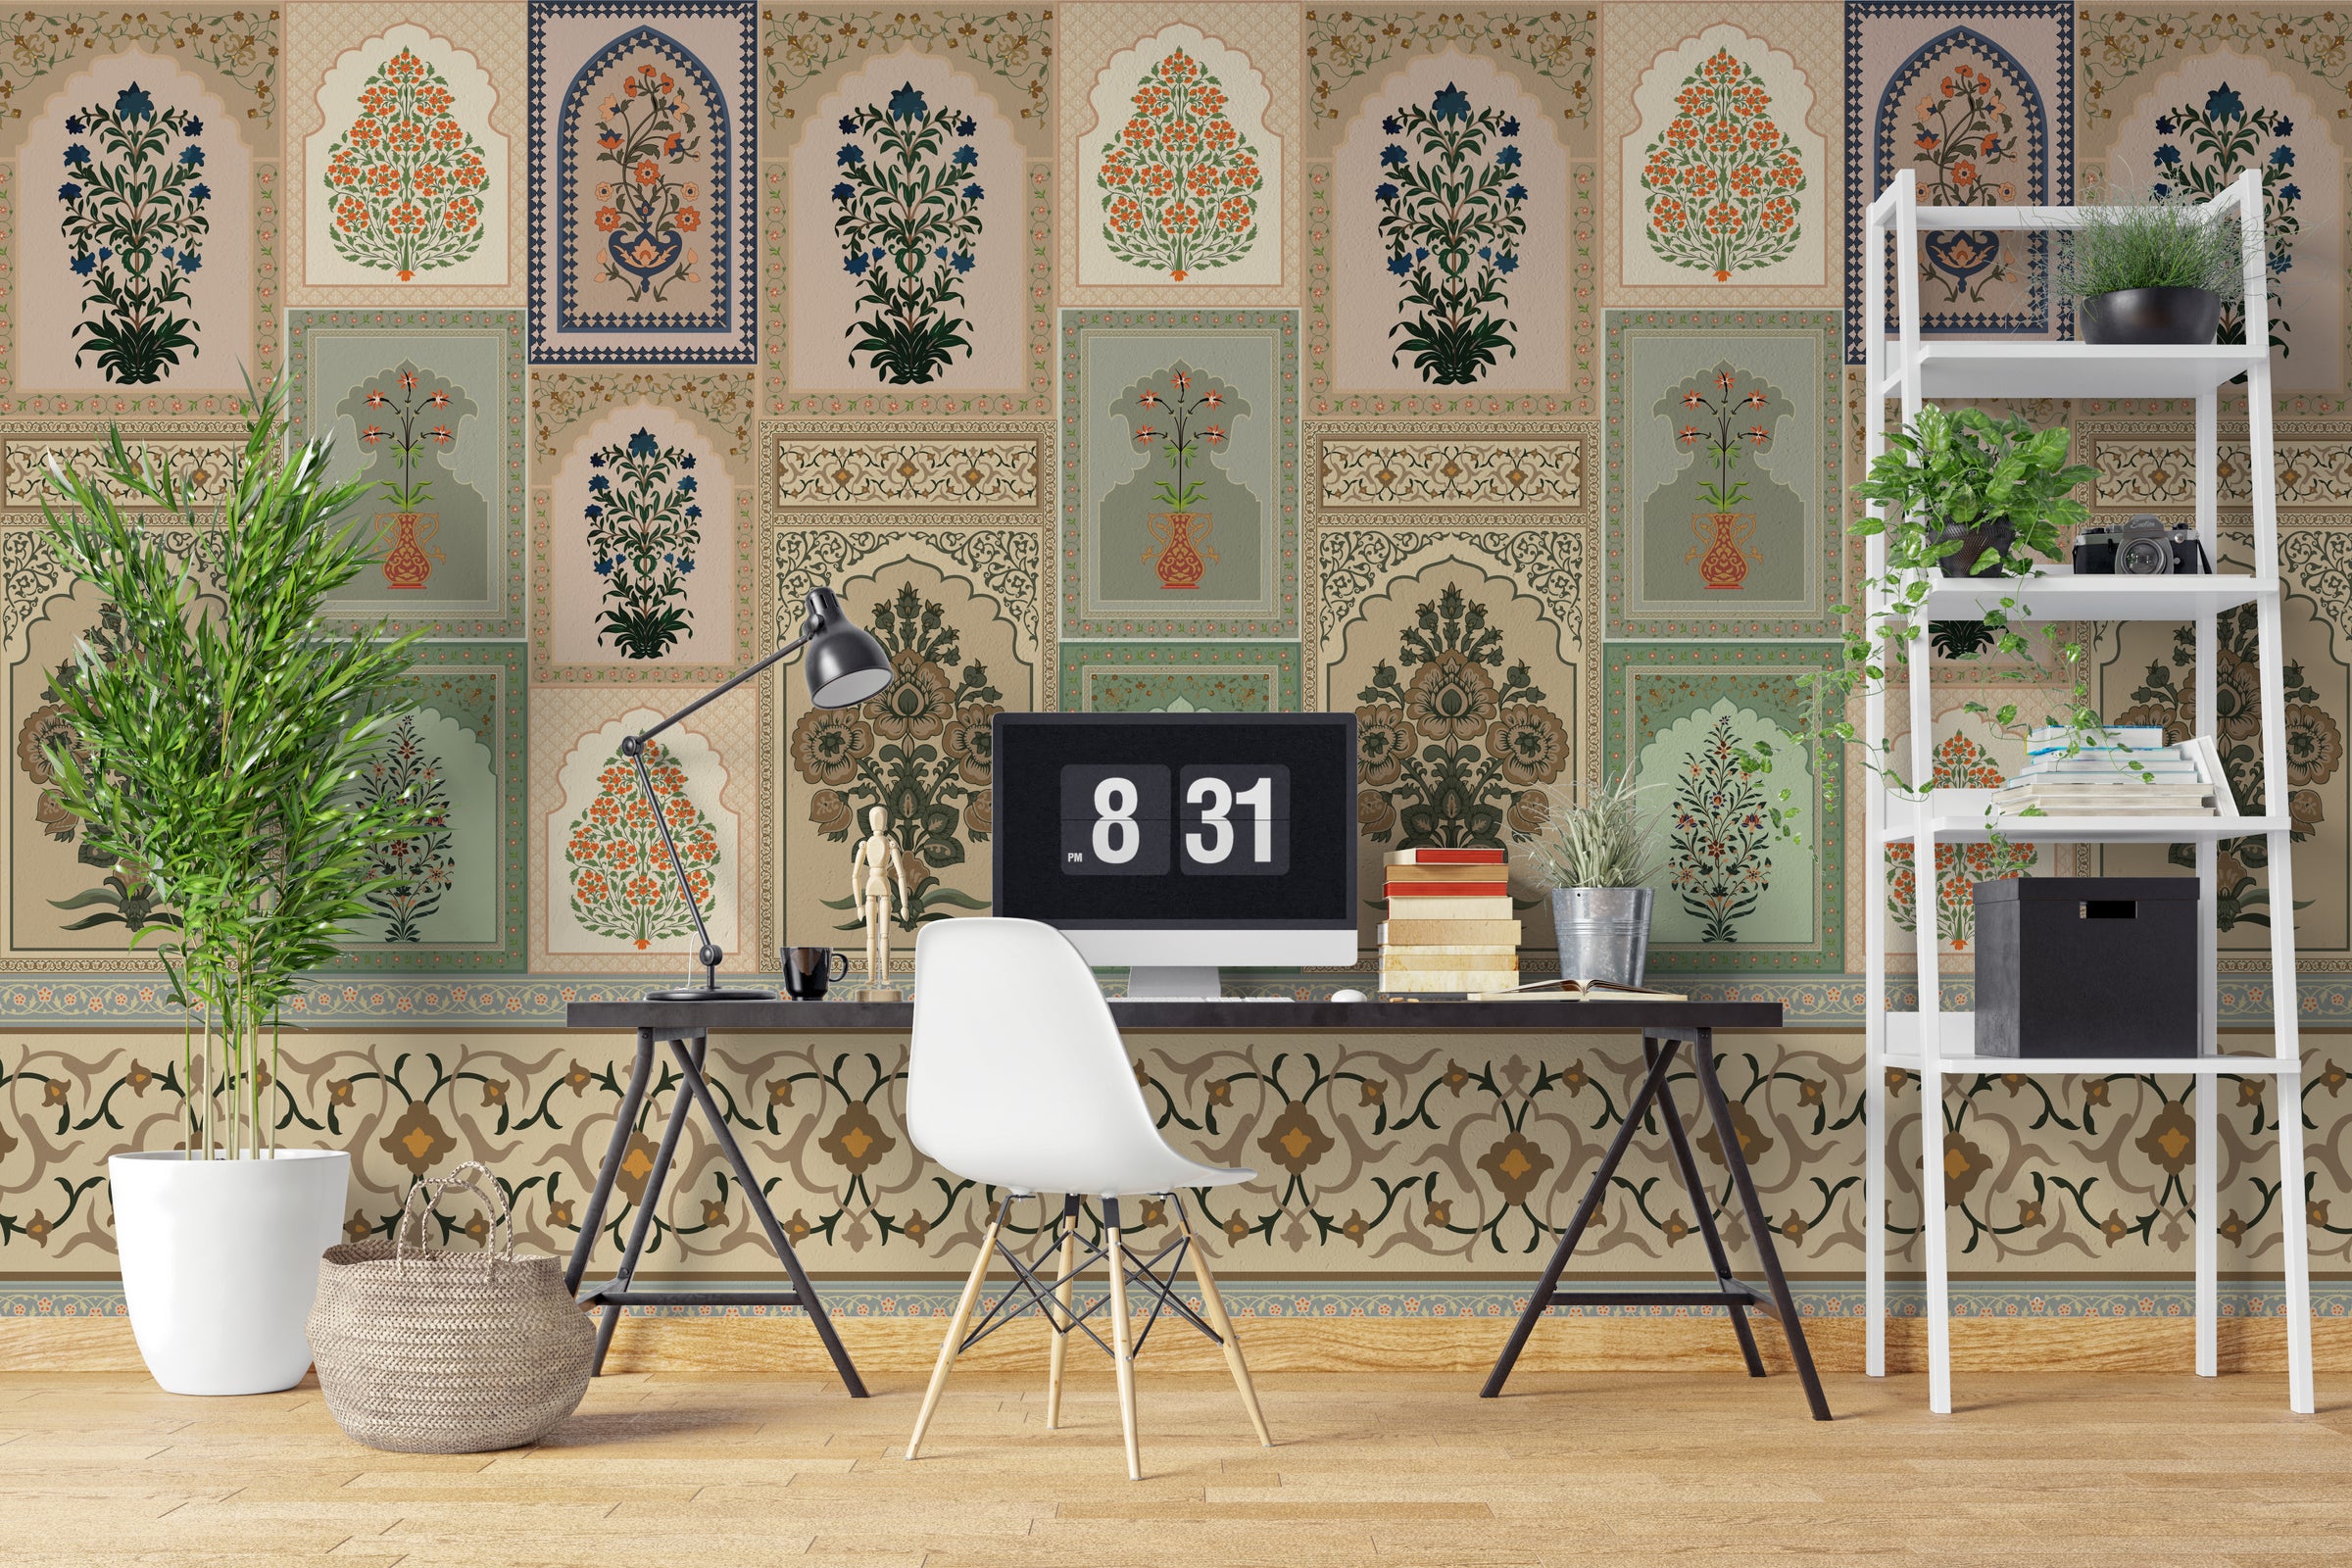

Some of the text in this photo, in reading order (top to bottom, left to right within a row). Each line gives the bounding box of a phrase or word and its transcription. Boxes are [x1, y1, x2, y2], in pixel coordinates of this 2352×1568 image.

[1092, 777, 1272, 864] 8 31
[1067, 852, 1083, 862] PM
